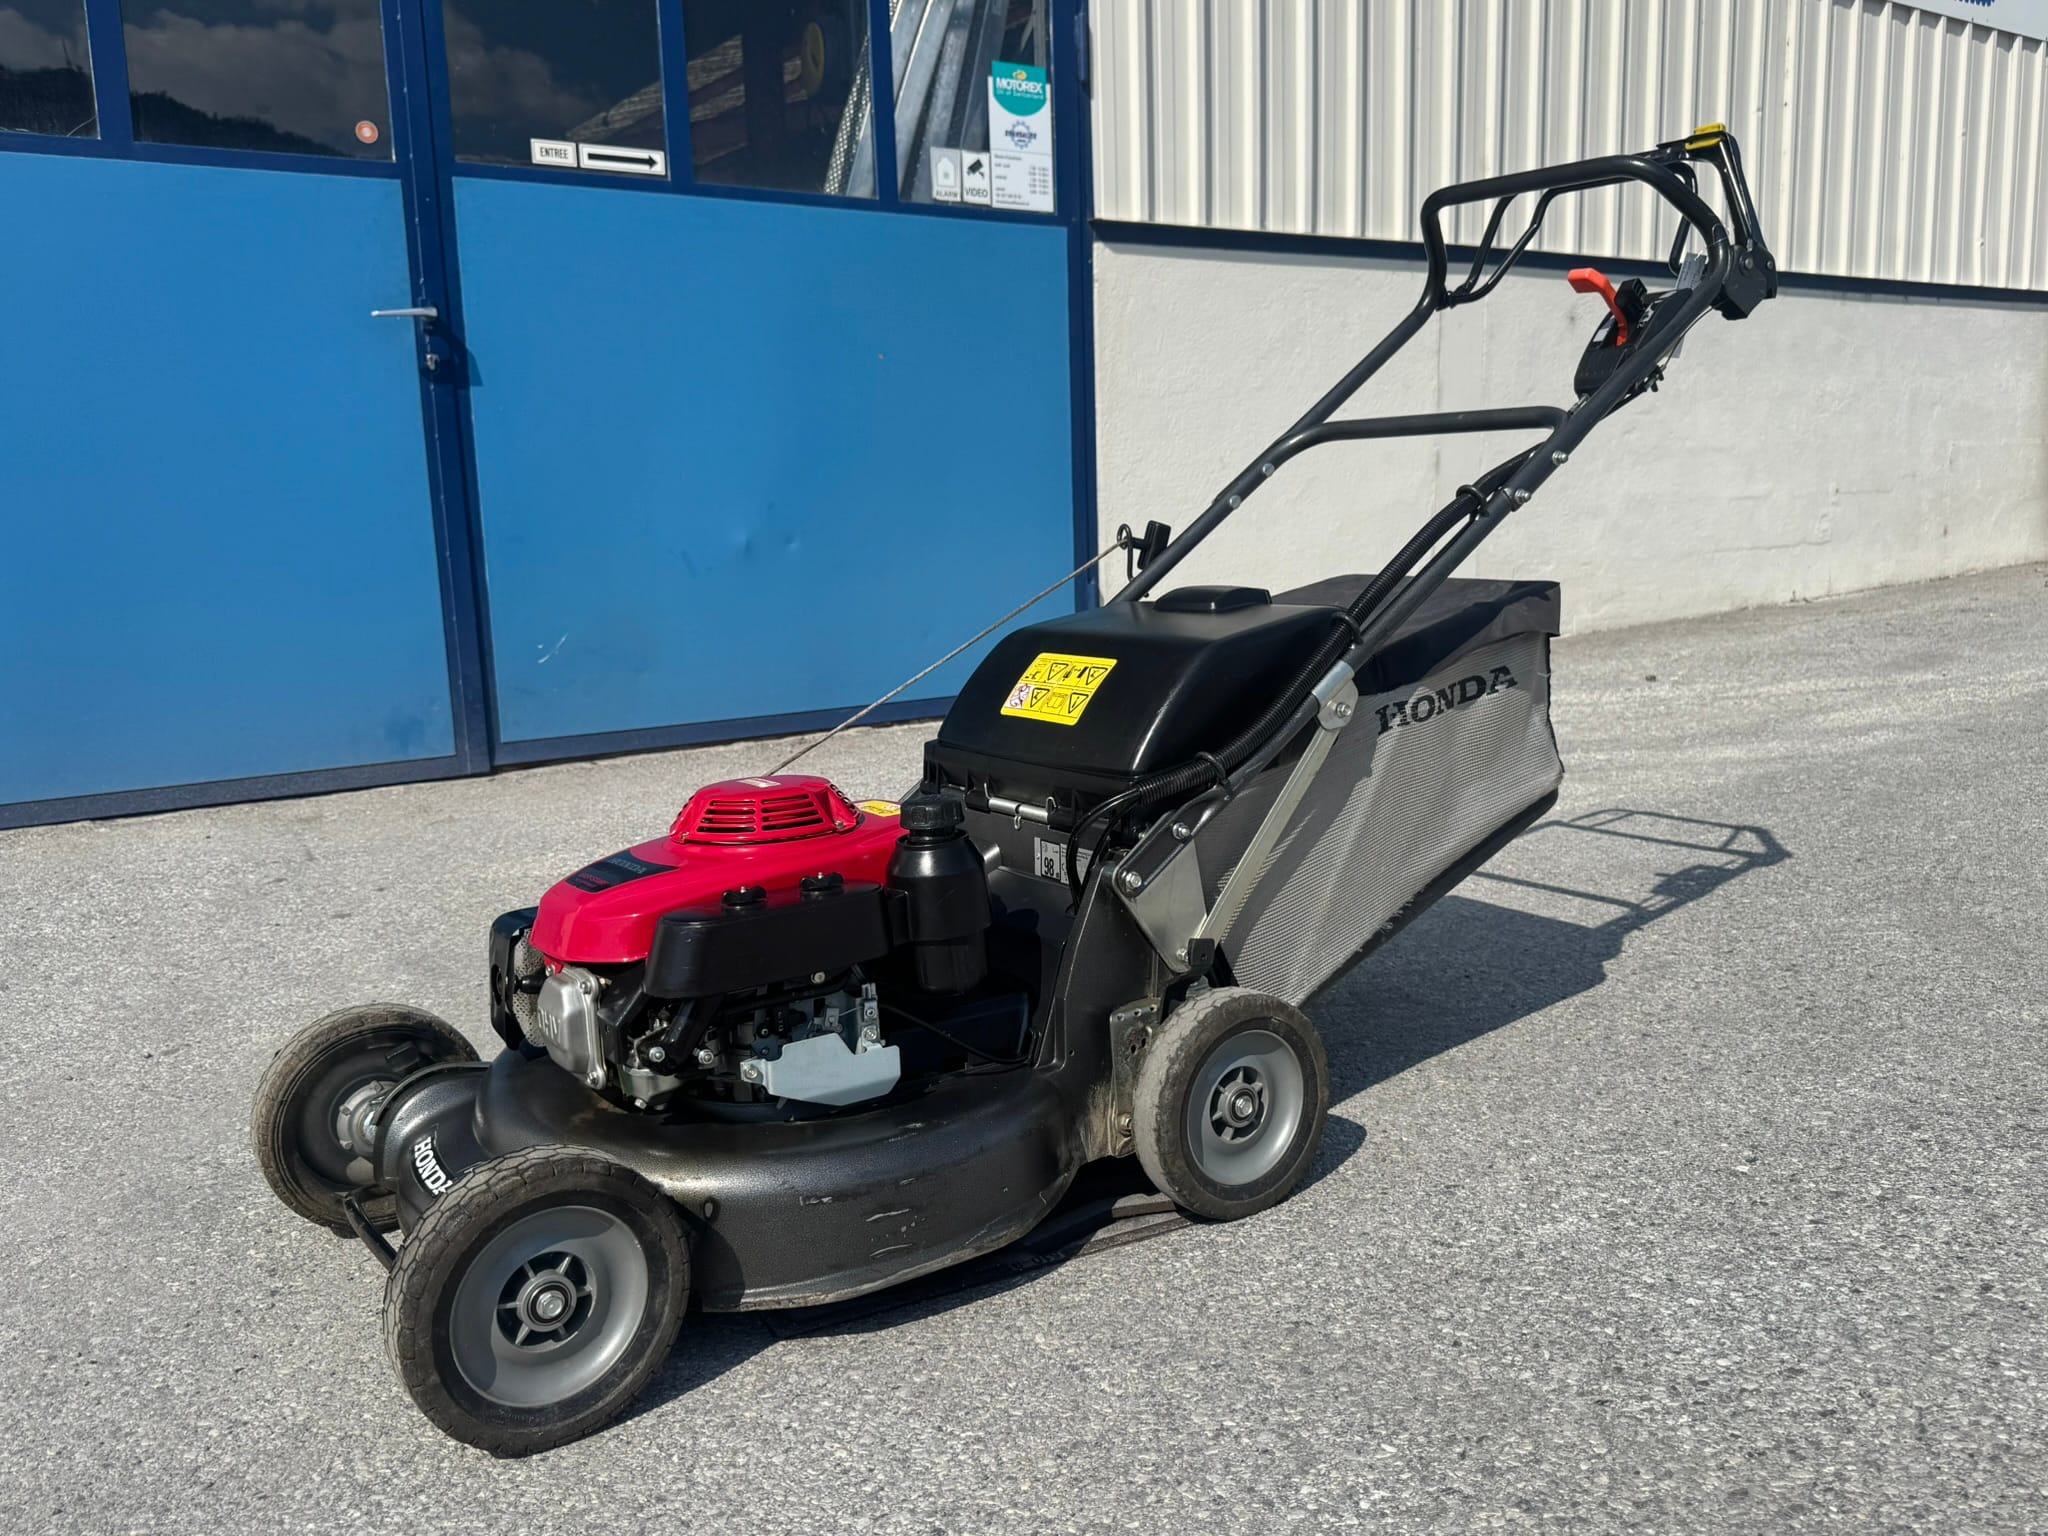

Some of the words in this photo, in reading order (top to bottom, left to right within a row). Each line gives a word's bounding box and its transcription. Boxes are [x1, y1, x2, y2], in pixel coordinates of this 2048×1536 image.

[995, 77, 1043, 95] MOTOREX
[539, 146, 569, 160] ENTREE
[965, 187, 989, 199] VIDEO
[1375, 665, 1518, 735] HONDA
[1044, 856, 1055, 876] 98
